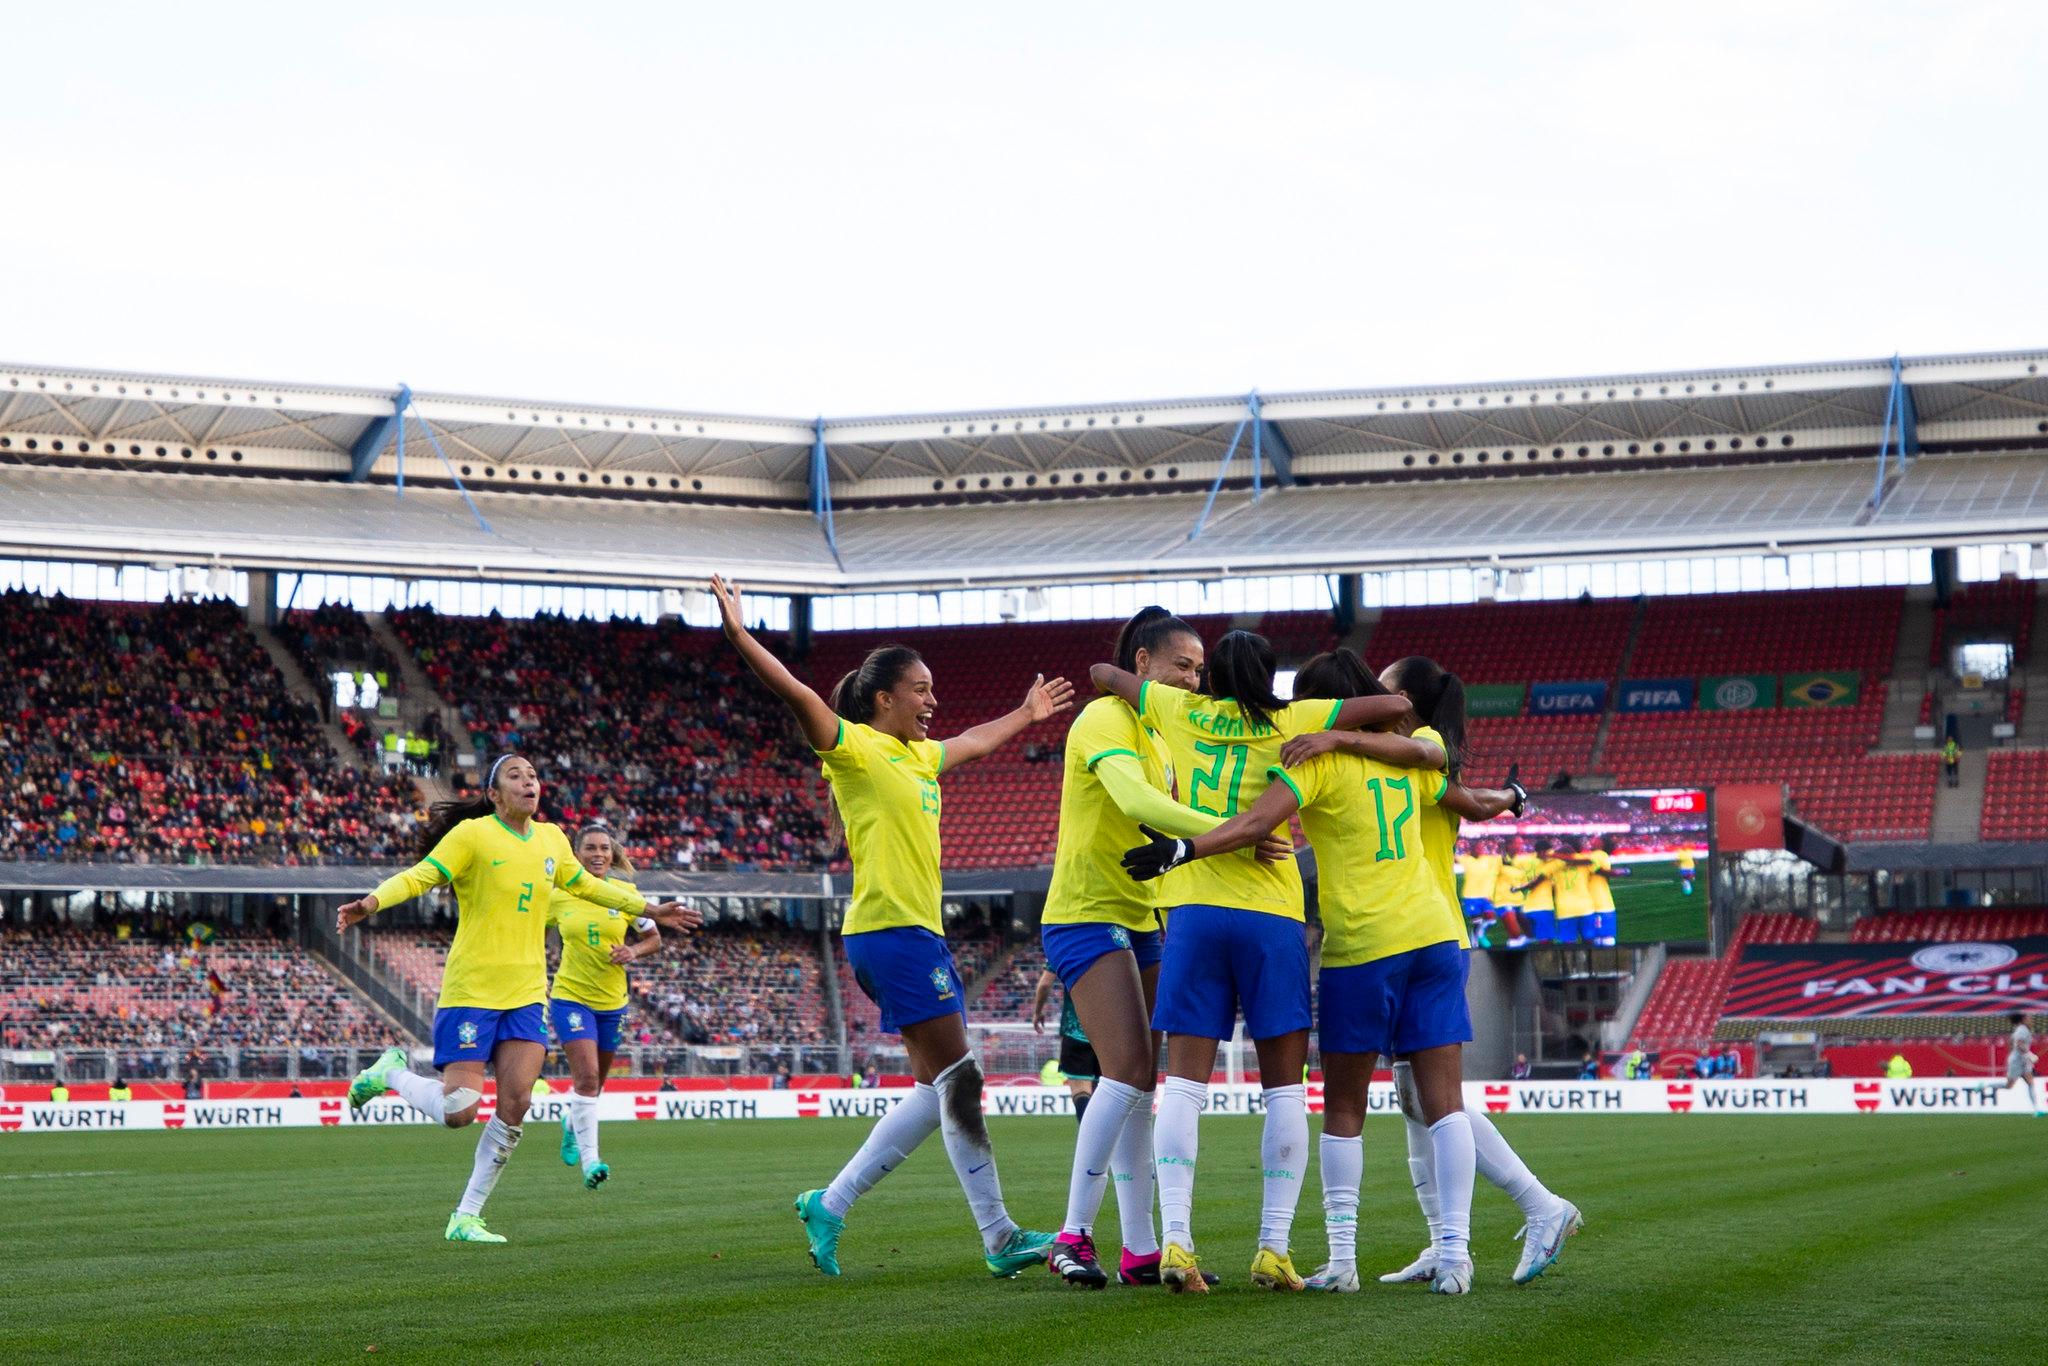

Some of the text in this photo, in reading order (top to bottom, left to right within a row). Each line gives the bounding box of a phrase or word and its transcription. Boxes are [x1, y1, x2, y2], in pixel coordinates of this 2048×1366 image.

[1537, 693, 1596, 710] UEFA
[1628, 689, 1682, 707] FIFA
[1190, 741, 1248, 818] 21
[1367, 776, 1415, 863] 17
[518, 883, 533, 912] 2
[1804, 977, 1925, 997] FAN
[829, 1097, 903, 1116] WÜRT
[996, 1094, 1071, 1113] WÜRT
[1519, 1089, 1622, 1109] WÜRTH
[1703, 1088, 1807, 1108] WÜRTH
[1891, 1087, 1998, 1107] WÜRTH
[32, 1109, 125, 1128] WÜRTH
[194, 1107, 282, 1127] WÜRTH
[667, 1100, 757, 1119] WÜRTH
